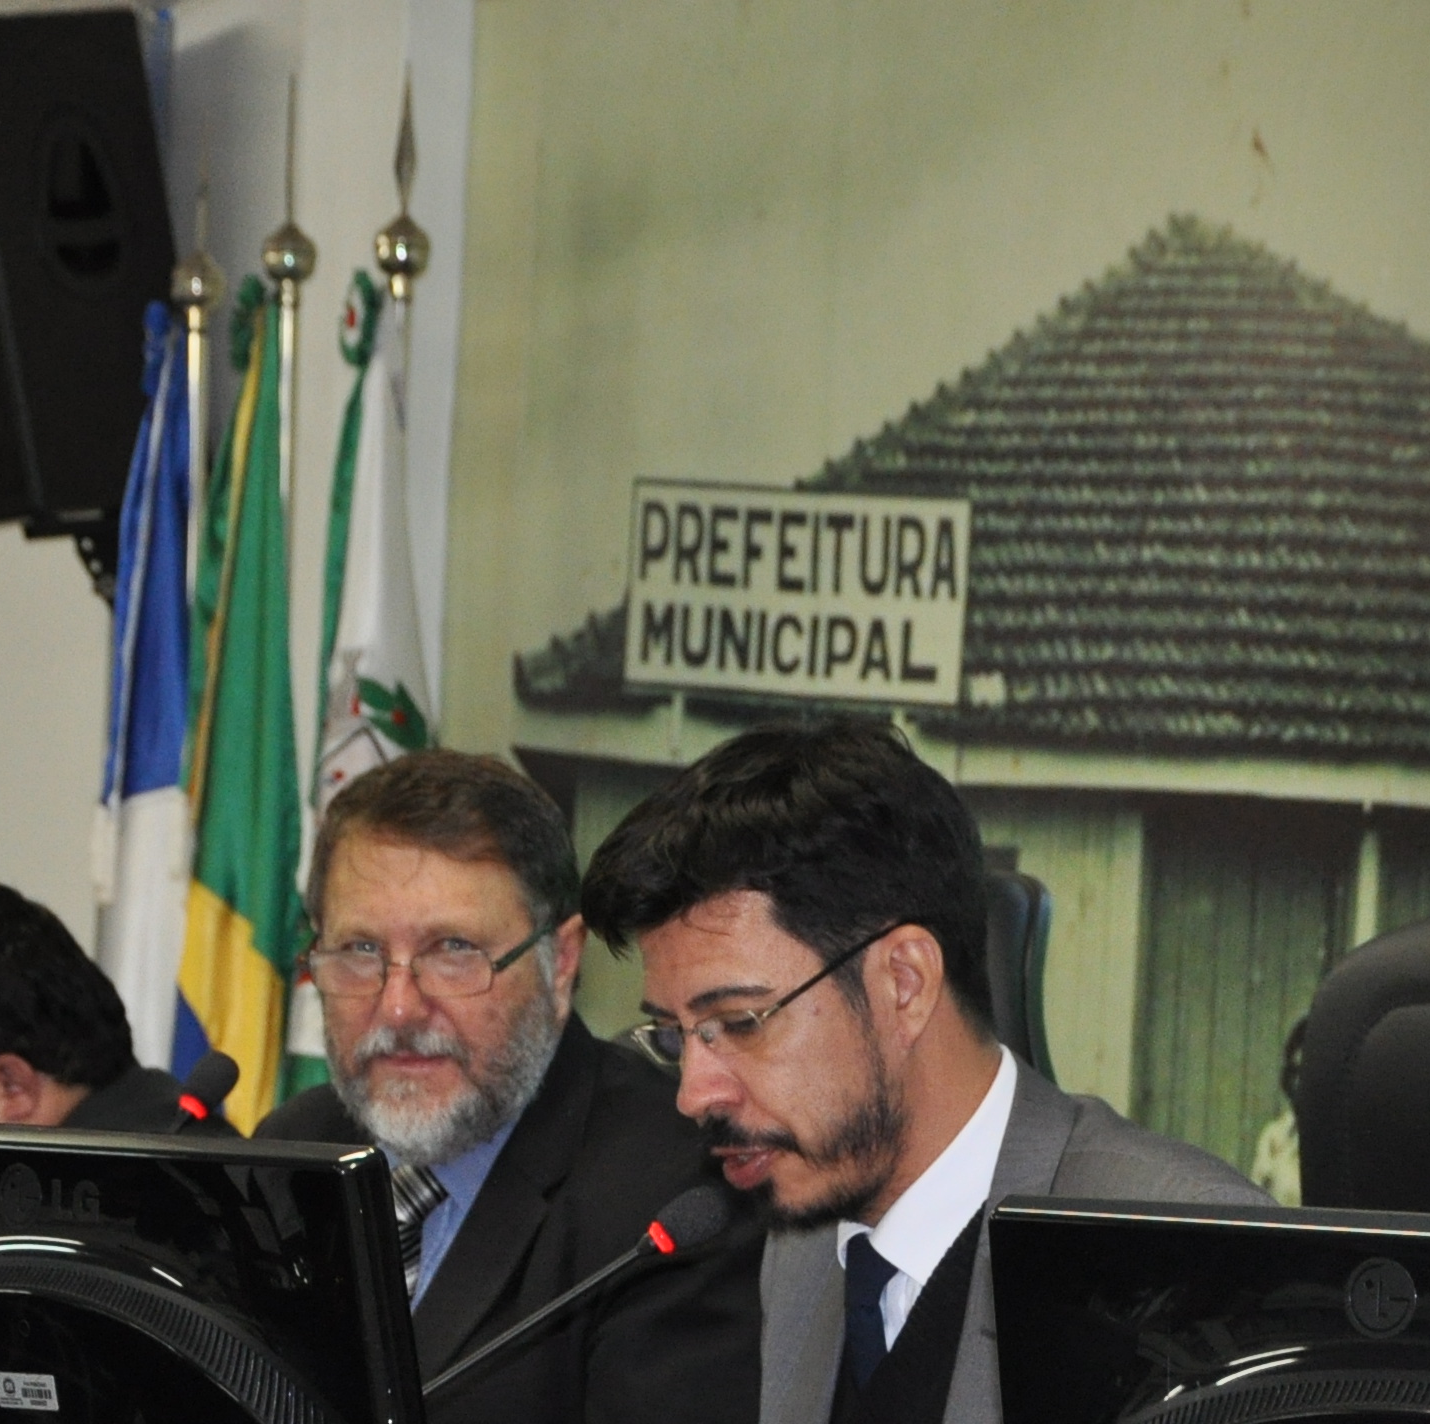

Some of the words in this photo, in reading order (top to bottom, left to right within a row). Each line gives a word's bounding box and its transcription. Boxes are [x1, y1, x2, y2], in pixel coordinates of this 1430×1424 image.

[639, 500, 957, 600] PREFEITURA
[641, 602, 937, 682] MUNICIPAL
[52, 1178, 100, 1222] LG
